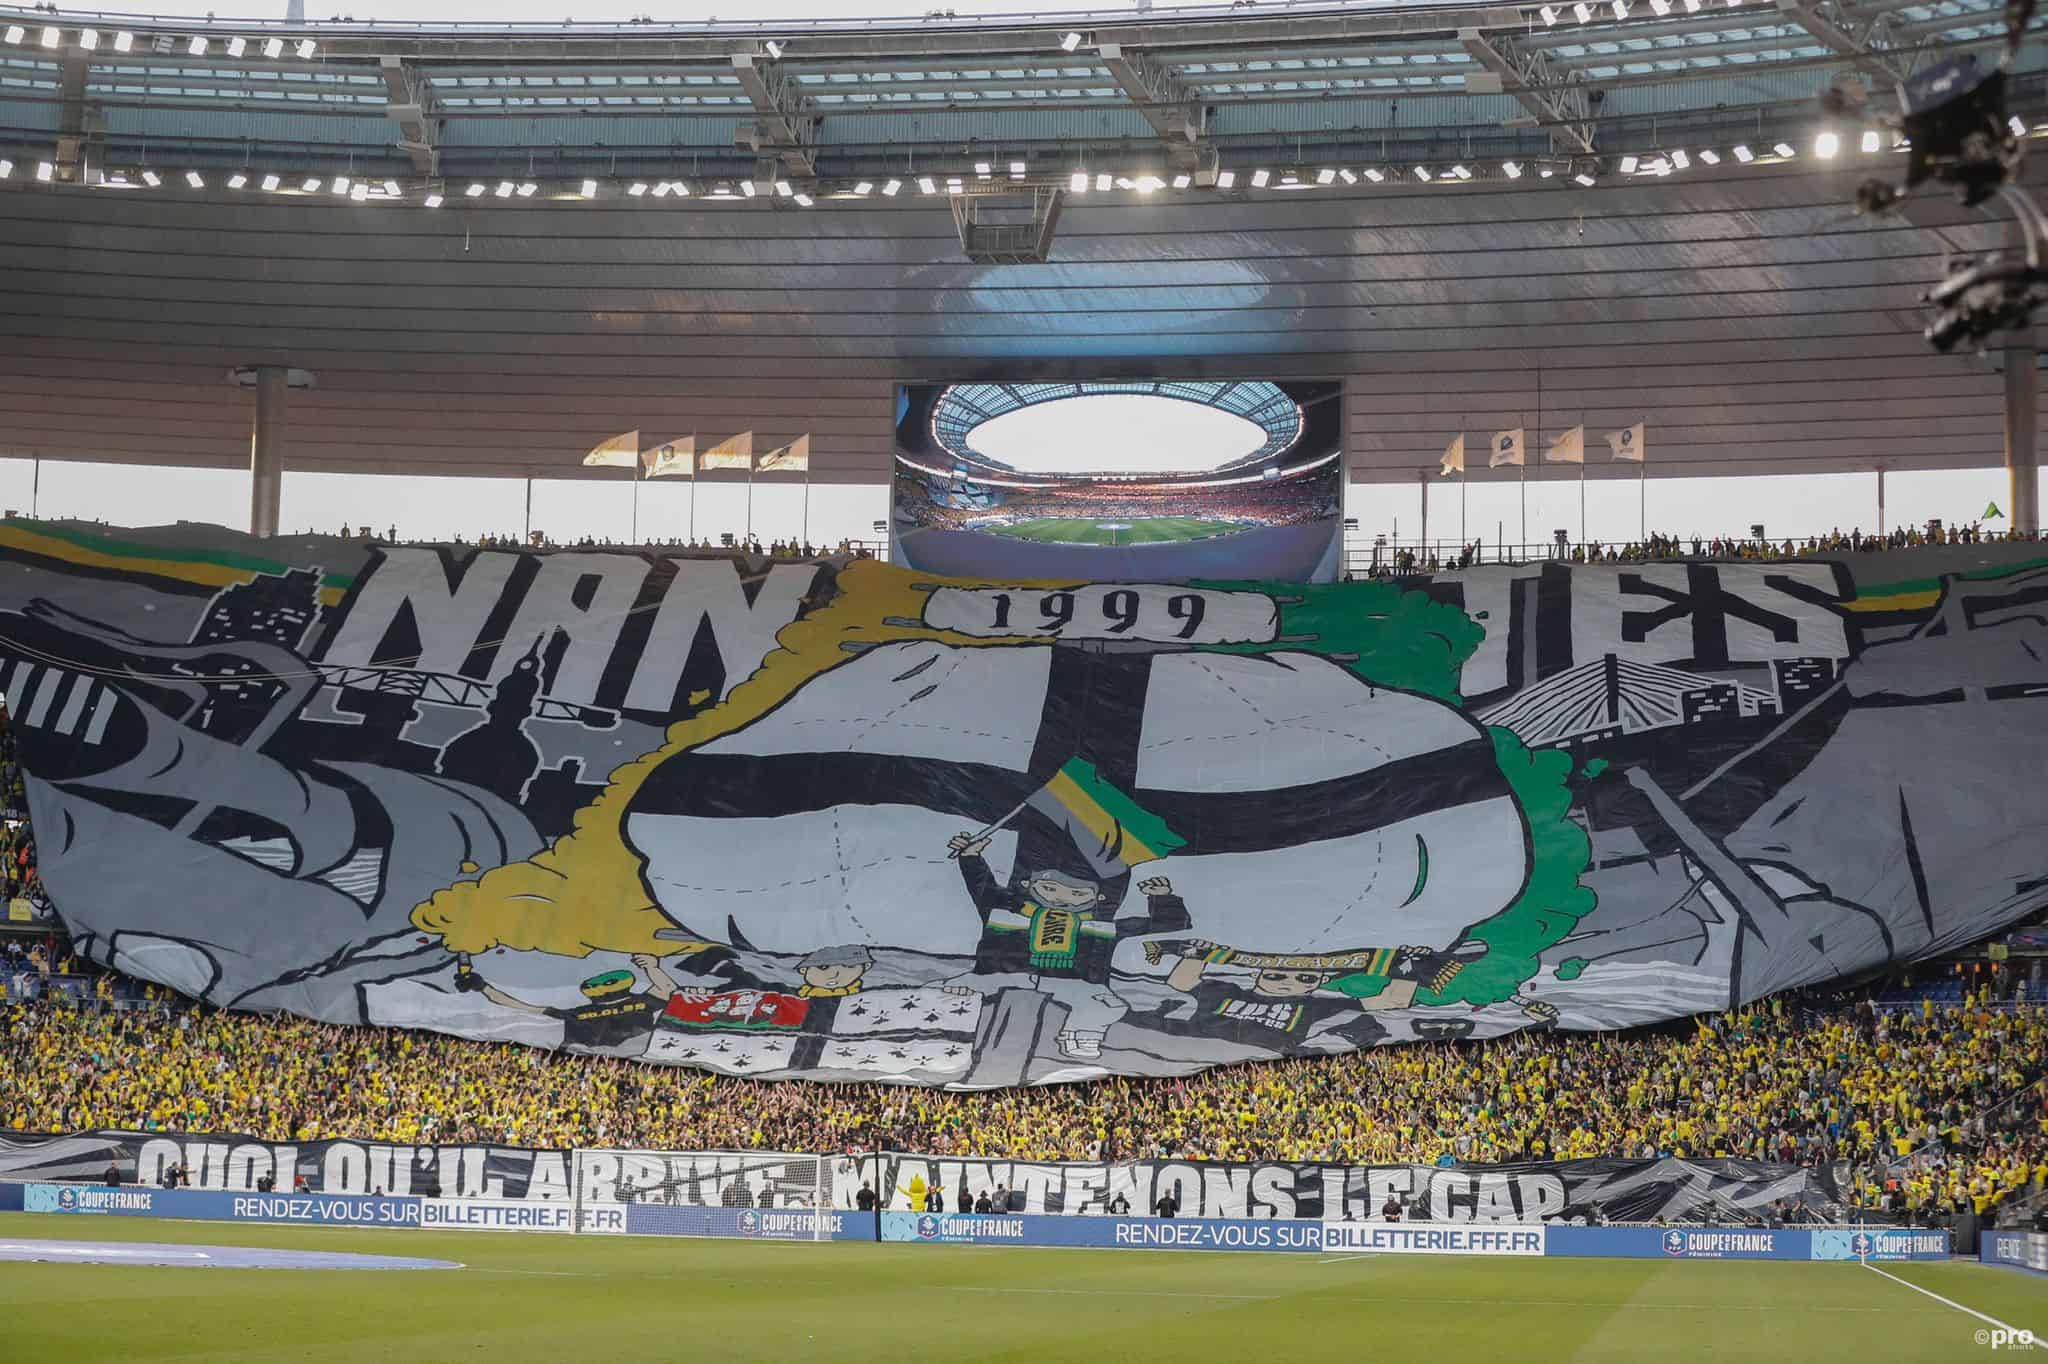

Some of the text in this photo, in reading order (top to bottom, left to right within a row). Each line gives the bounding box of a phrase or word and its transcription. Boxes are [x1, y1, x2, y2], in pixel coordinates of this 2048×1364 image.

[988, 589, 1206, 639] 1999
[79, 1192, 108, 1208] COUPE
[115, 1193, 152, 1210] FRANCE
[1430, 1168, 1567, 1225] CAP
[233, 1197, 622, 1229] RENDEZ-VOUS SUR BILLETTERIE.FF.FR
[762, 1214, 796, 1231] COUPE
[941, 1218, 976, 1233] COUPE
[983, 1219, 1023, 1237] FRANCE
[1115, 1222, 1540, 1252] RENDEZ-VOUS SUR BILLETTERIE.FFF.FR
[1689, 1233, 1725, 1248] COUPE
[1731, 1234, 1773, 1252] FRANCE
[1876, 1236, 1908, 1253] COUPE
[1914, 1237, 1944, 1253] FRANCE
